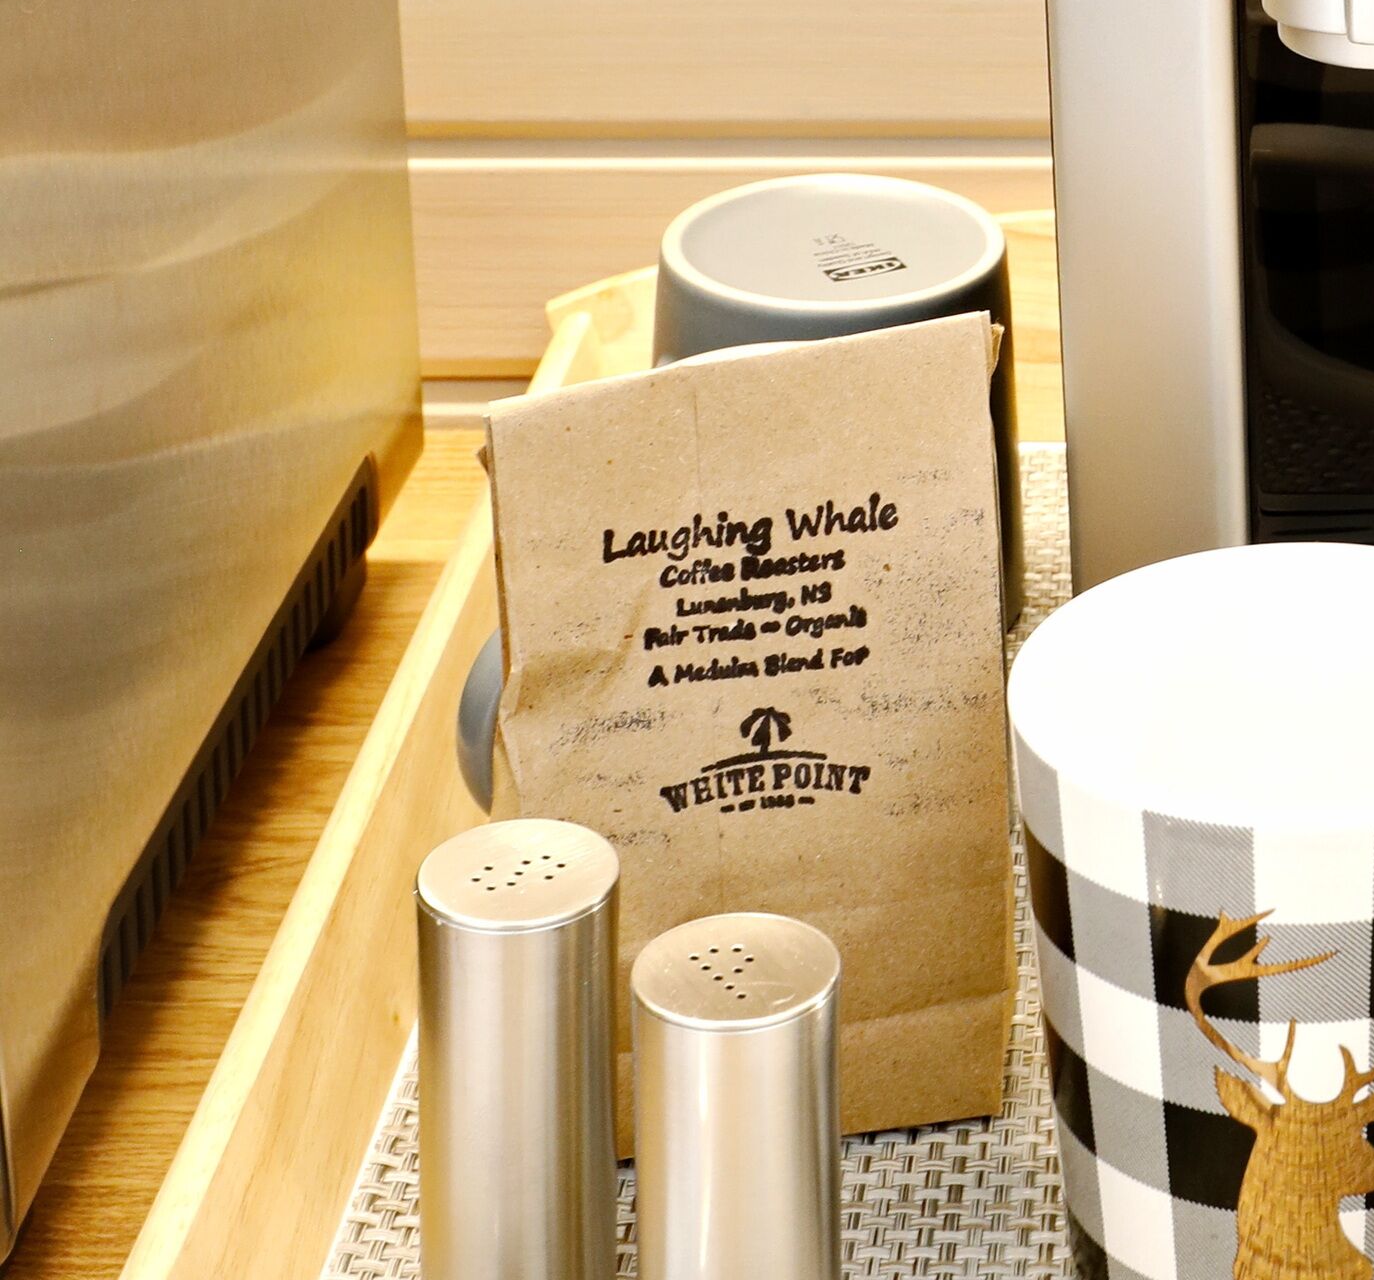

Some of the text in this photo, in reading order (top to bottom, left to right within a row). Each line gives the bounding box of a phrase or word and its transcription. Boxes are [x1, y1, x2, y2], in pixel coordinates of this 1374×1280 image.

[602, 492, 899, 564] Laughing Whale
[659, 549, 846, 588] Coffee Roasters
[643, 624, 690, 651] Fair
[692, 618, 757, 644] Trade
[647, 665, 670, 688] A
[763, 648, 825, 677] Blend
[659, 762, 871, 813] WHITE POINT
